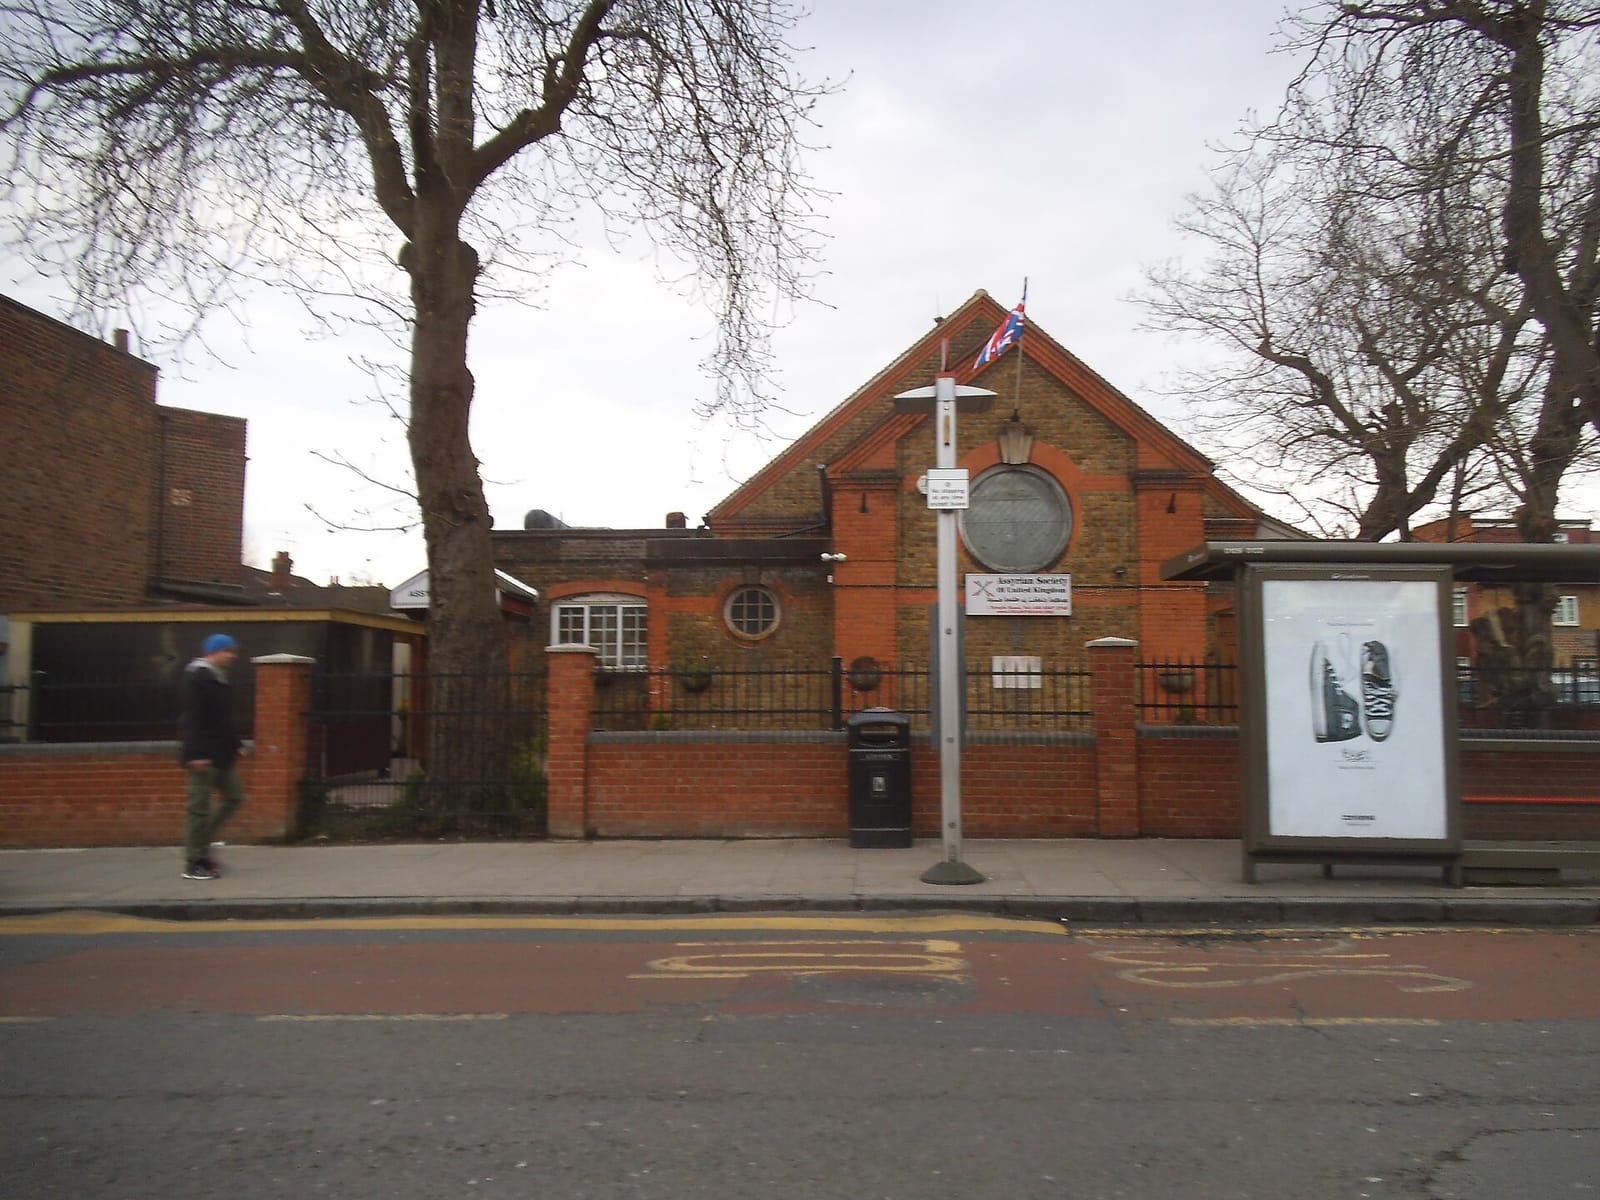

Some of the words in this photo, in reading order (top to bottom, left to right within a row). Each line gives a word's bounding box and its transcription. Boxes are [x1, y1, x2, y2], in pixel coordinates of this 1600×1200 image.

[998, 576, 1034, 586] Assyrian
[1036, 576, 1067, 587] Society
[1033, 586, 1066, 595] Kingdom
